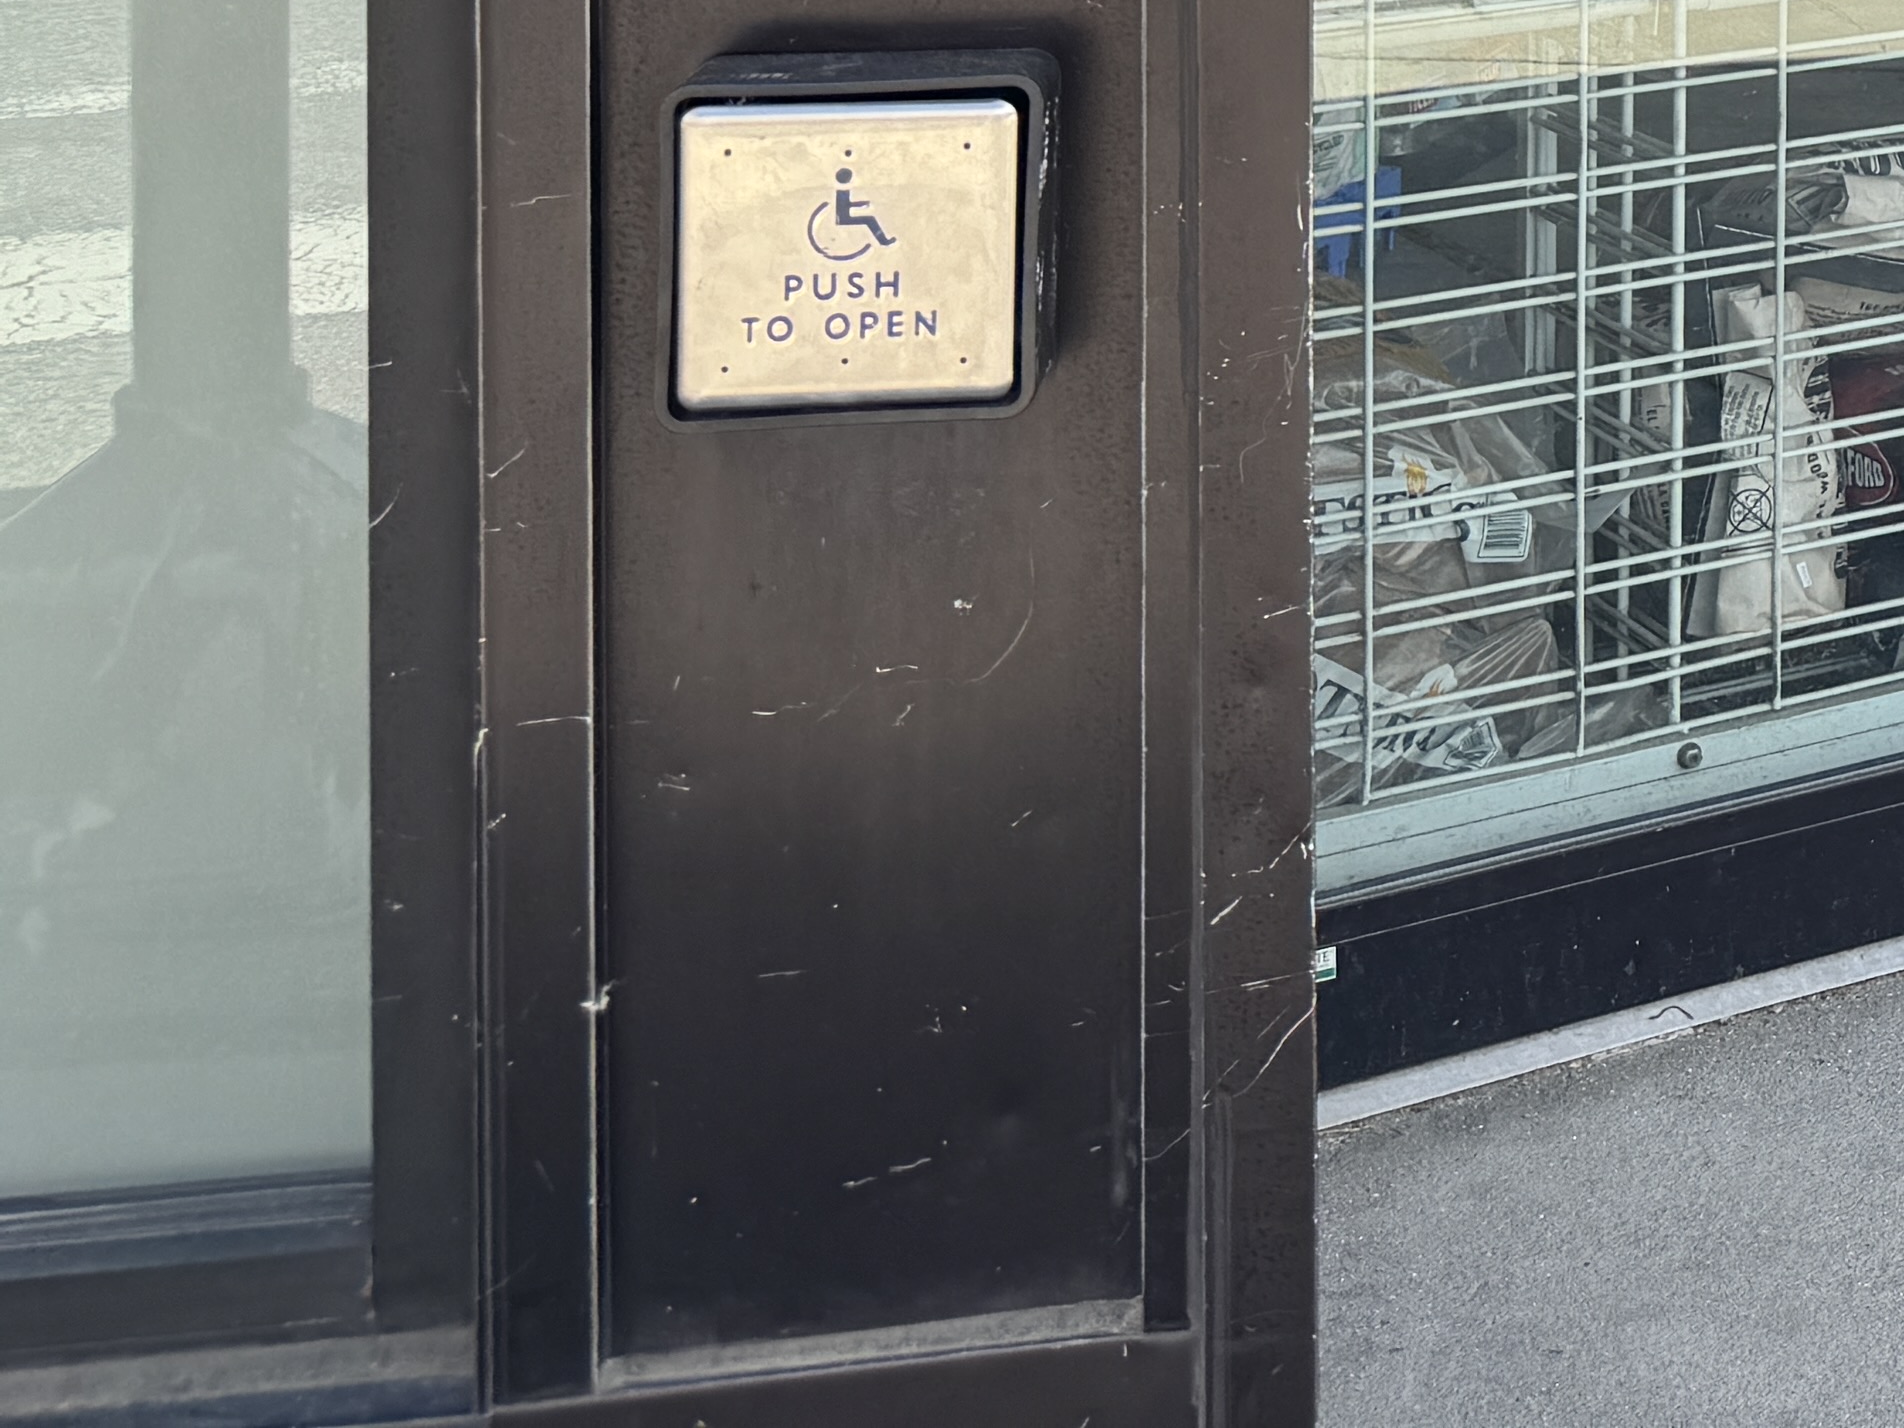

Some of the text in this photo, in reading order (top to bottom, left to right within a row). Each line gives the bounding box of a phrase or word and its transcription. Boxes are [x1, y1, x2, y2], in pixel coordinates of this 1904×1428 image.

[783, 270, 901, 301] PUSH
[742, 309, 938, 343] TO OPEN
